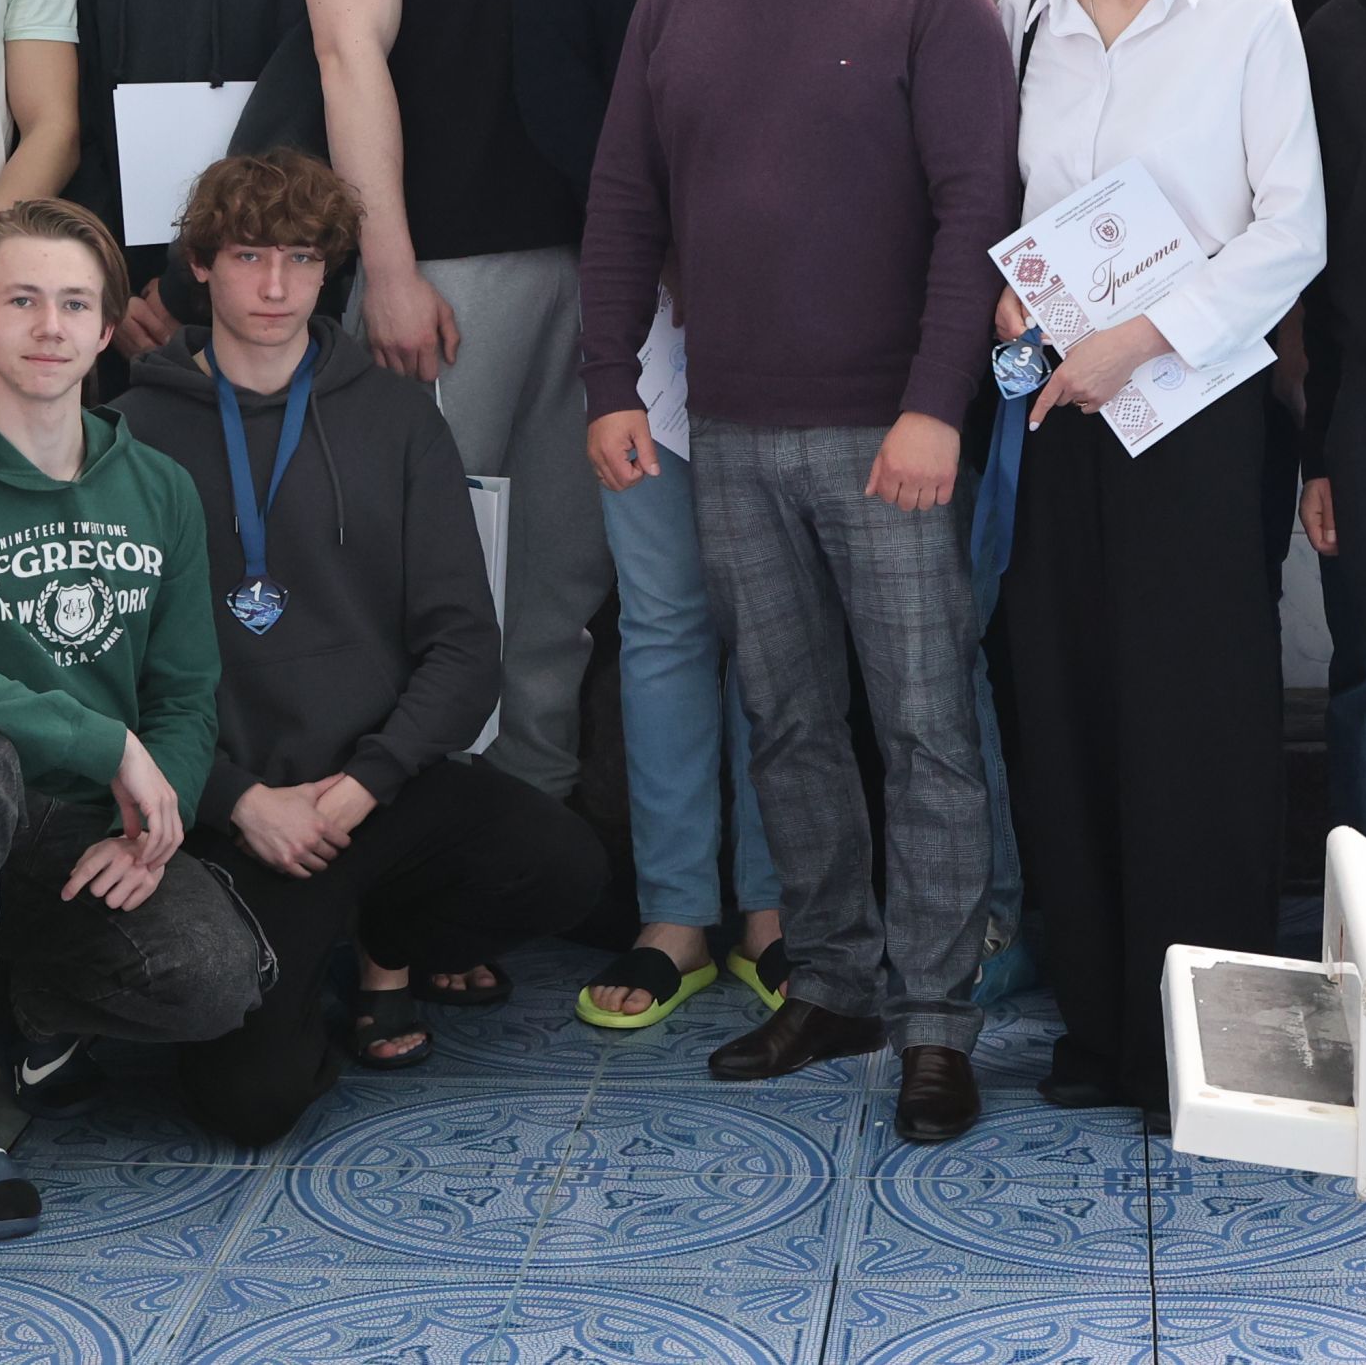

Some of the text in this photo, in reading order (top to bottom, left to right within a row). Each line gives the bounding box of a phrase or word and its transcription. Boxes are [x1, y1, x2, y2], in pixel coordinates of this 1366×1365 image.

[1087, 237, 1182, 306] Грамота
[1014, 346, 1033, 368] 3
[0, 521, 65, 550] NINETEEN
[115, 586, 150, 615] ORK
[250, 581, 262, 600] 1
[101, 626, 124, 653] MARK
